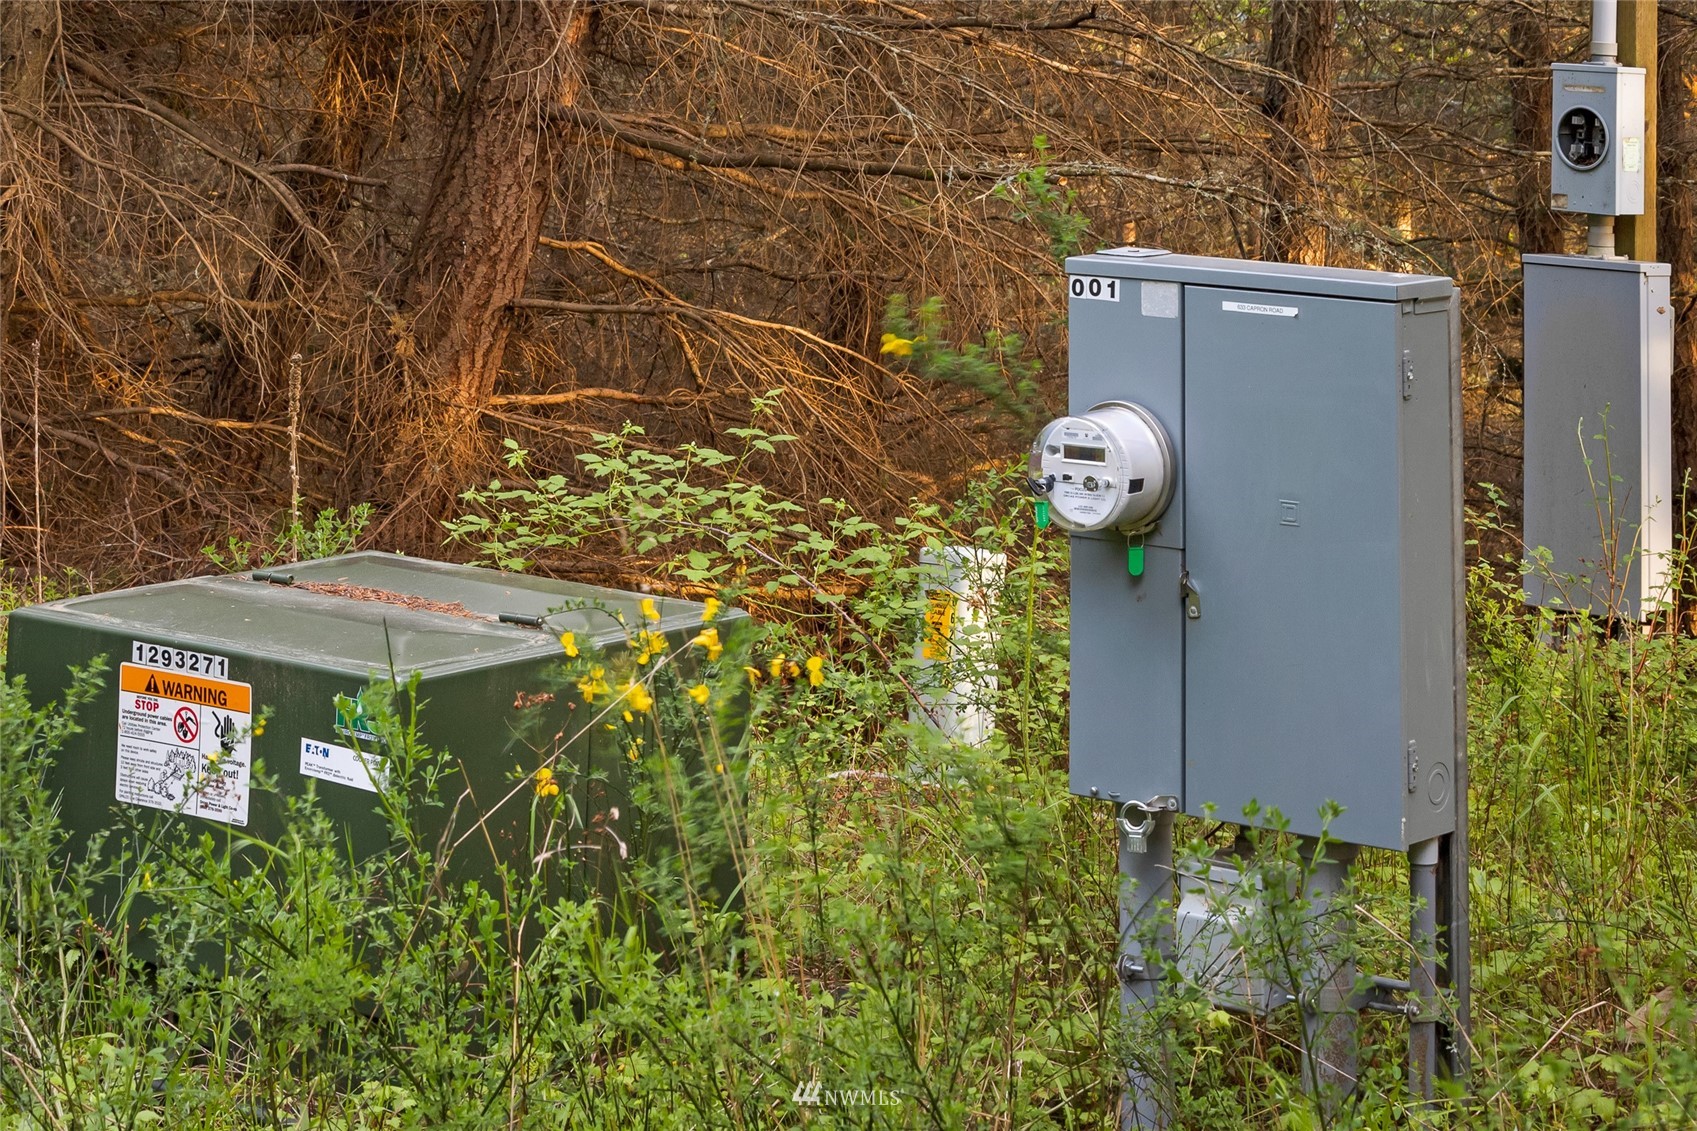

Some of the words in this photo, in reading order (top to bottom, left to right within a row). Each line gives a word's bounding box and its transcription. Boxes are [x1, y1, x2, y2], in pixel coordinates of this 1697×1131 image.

[1072, 278, 1116, 299] 001
[1246, 304, 1268, 312] CAPRON
[136, 644, 225, 676] 1293271
[162, 680, 228, 706] WARNING
[134, 699, 159, 712] STOP
[122, 709, 146, 718] Underground
[223, 770, 239, 780] out!
